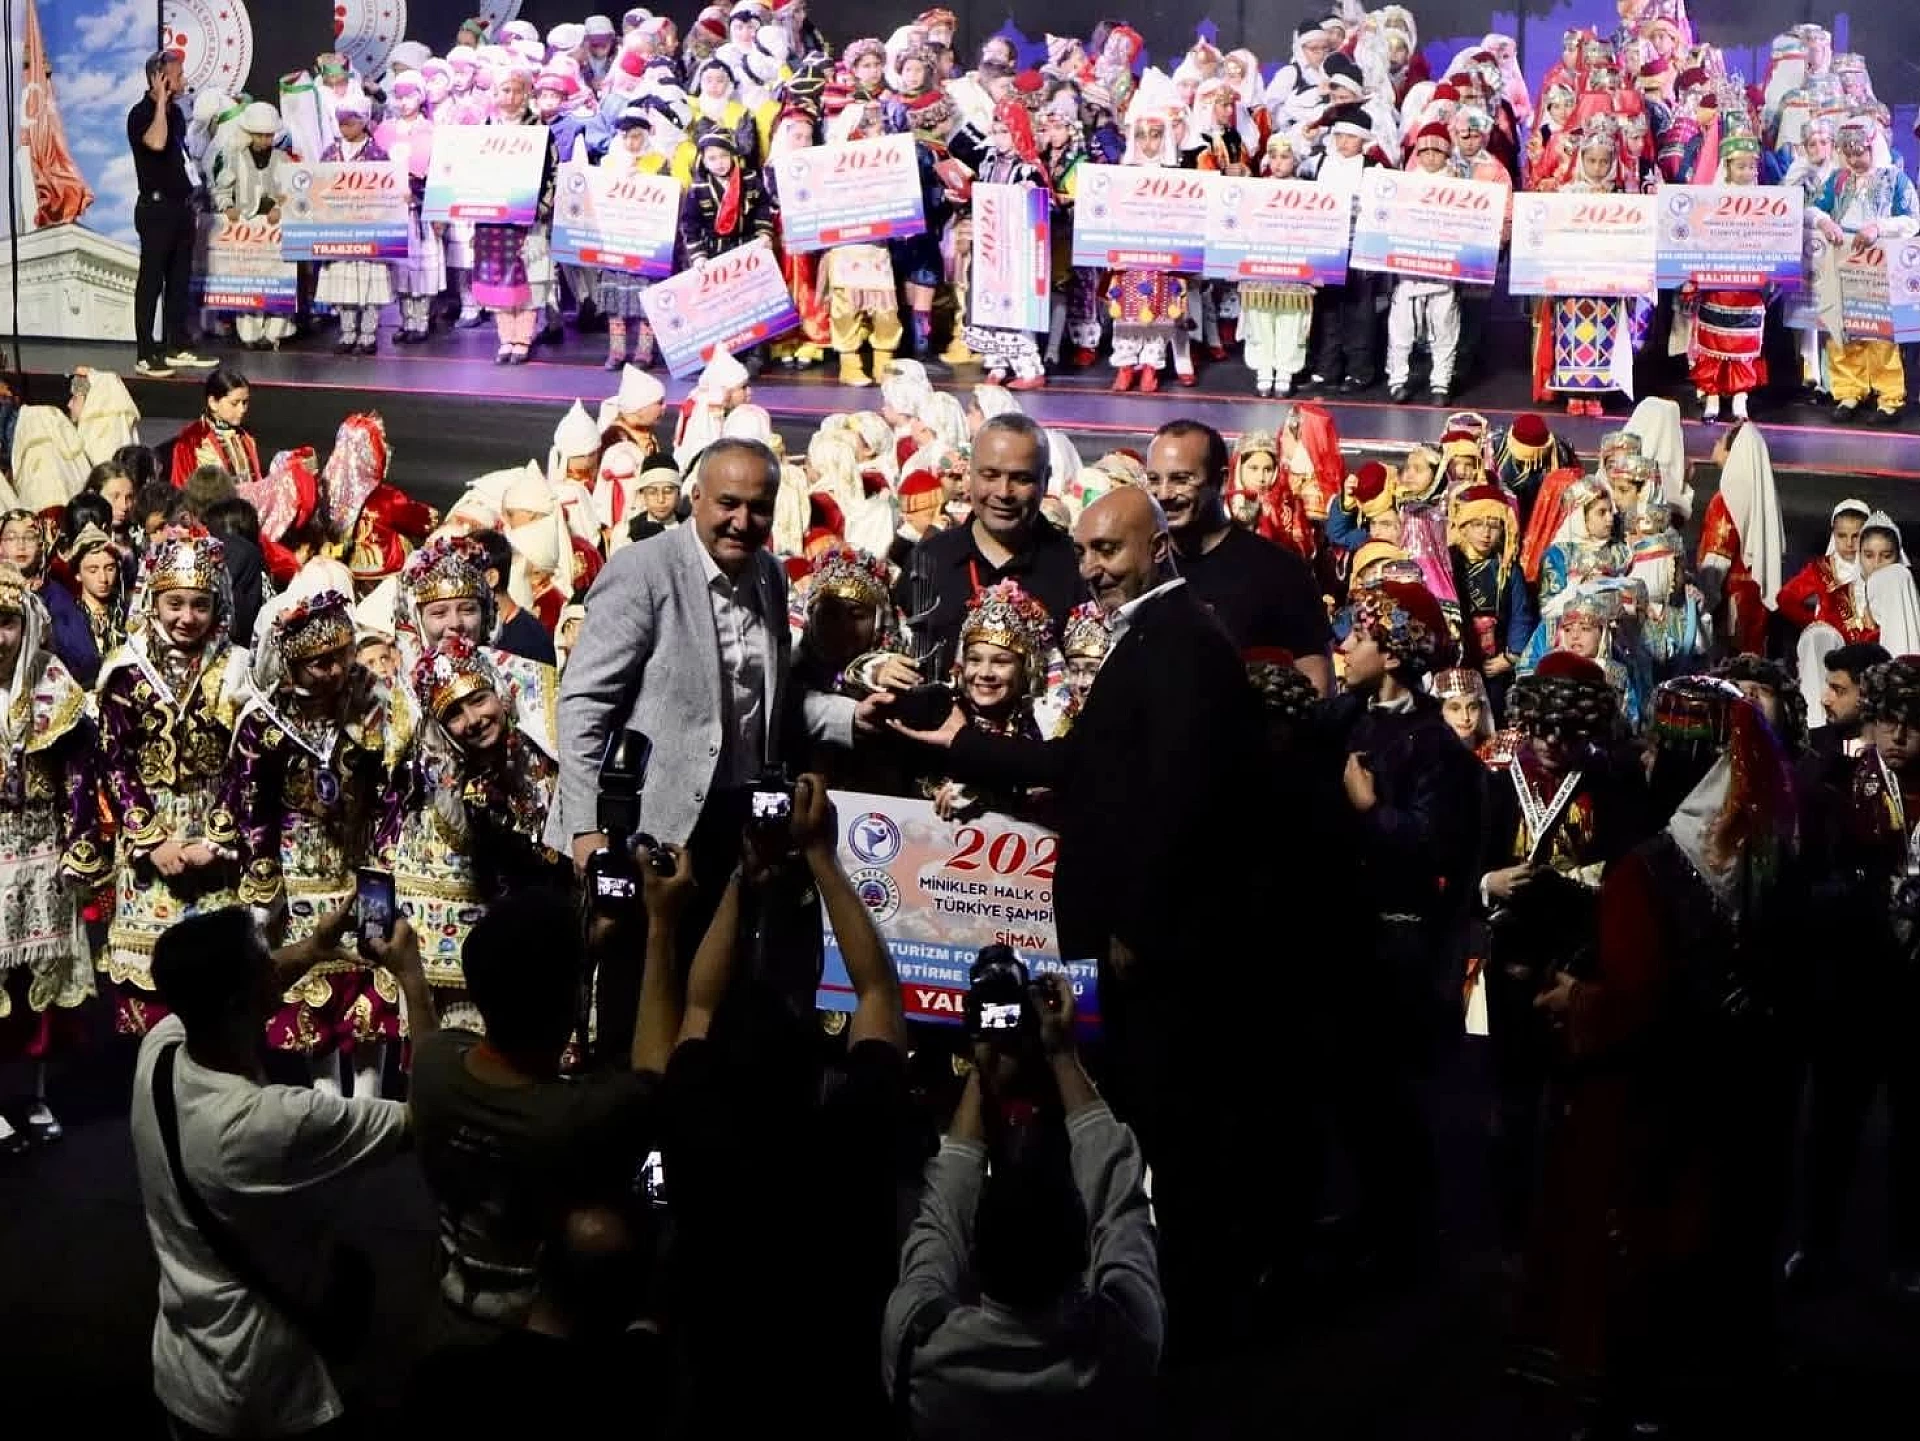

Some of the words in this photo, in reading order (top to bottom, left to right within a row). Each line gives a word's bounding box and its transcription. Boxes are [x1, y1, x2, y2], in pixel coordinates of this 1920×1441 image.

[479, 137, 533, 155] 2026
[834, 146, 901, 173] 2026
[333, 171, 394, 190] 2026
[1135, 177, 1204, 198] 2026
[605, 181, 666, 205] 2026
[1267, 189, 1336, 210] 2026
[1419, 187, 1490, 210] 2026
[1571, 204, 1642, 224] 2026
[1716, 197, 1787, 216] 2026
[219, 225, 282, 242] 2026
[980, 199, 996, 267] 2026
[1845, 247, 1885, 267] 20
[700, 254, 760, 293] 2026
[945, 827, 1059, 879] 202
[919, 875, 988, 896] MİNİKLER
[994, 885, 1034, 901] HALK
[934, 896, 1001, 917] TÜRKİYE
[1005, 906, 1054, 923] ŞAMPİ
[995, 928, 1048, 950] SİMAV
[886, 941, 950, 961] TURİZM
[897, 960, 963, 982] İŞTİRME
[915, 989, 965, 1013] YAL
